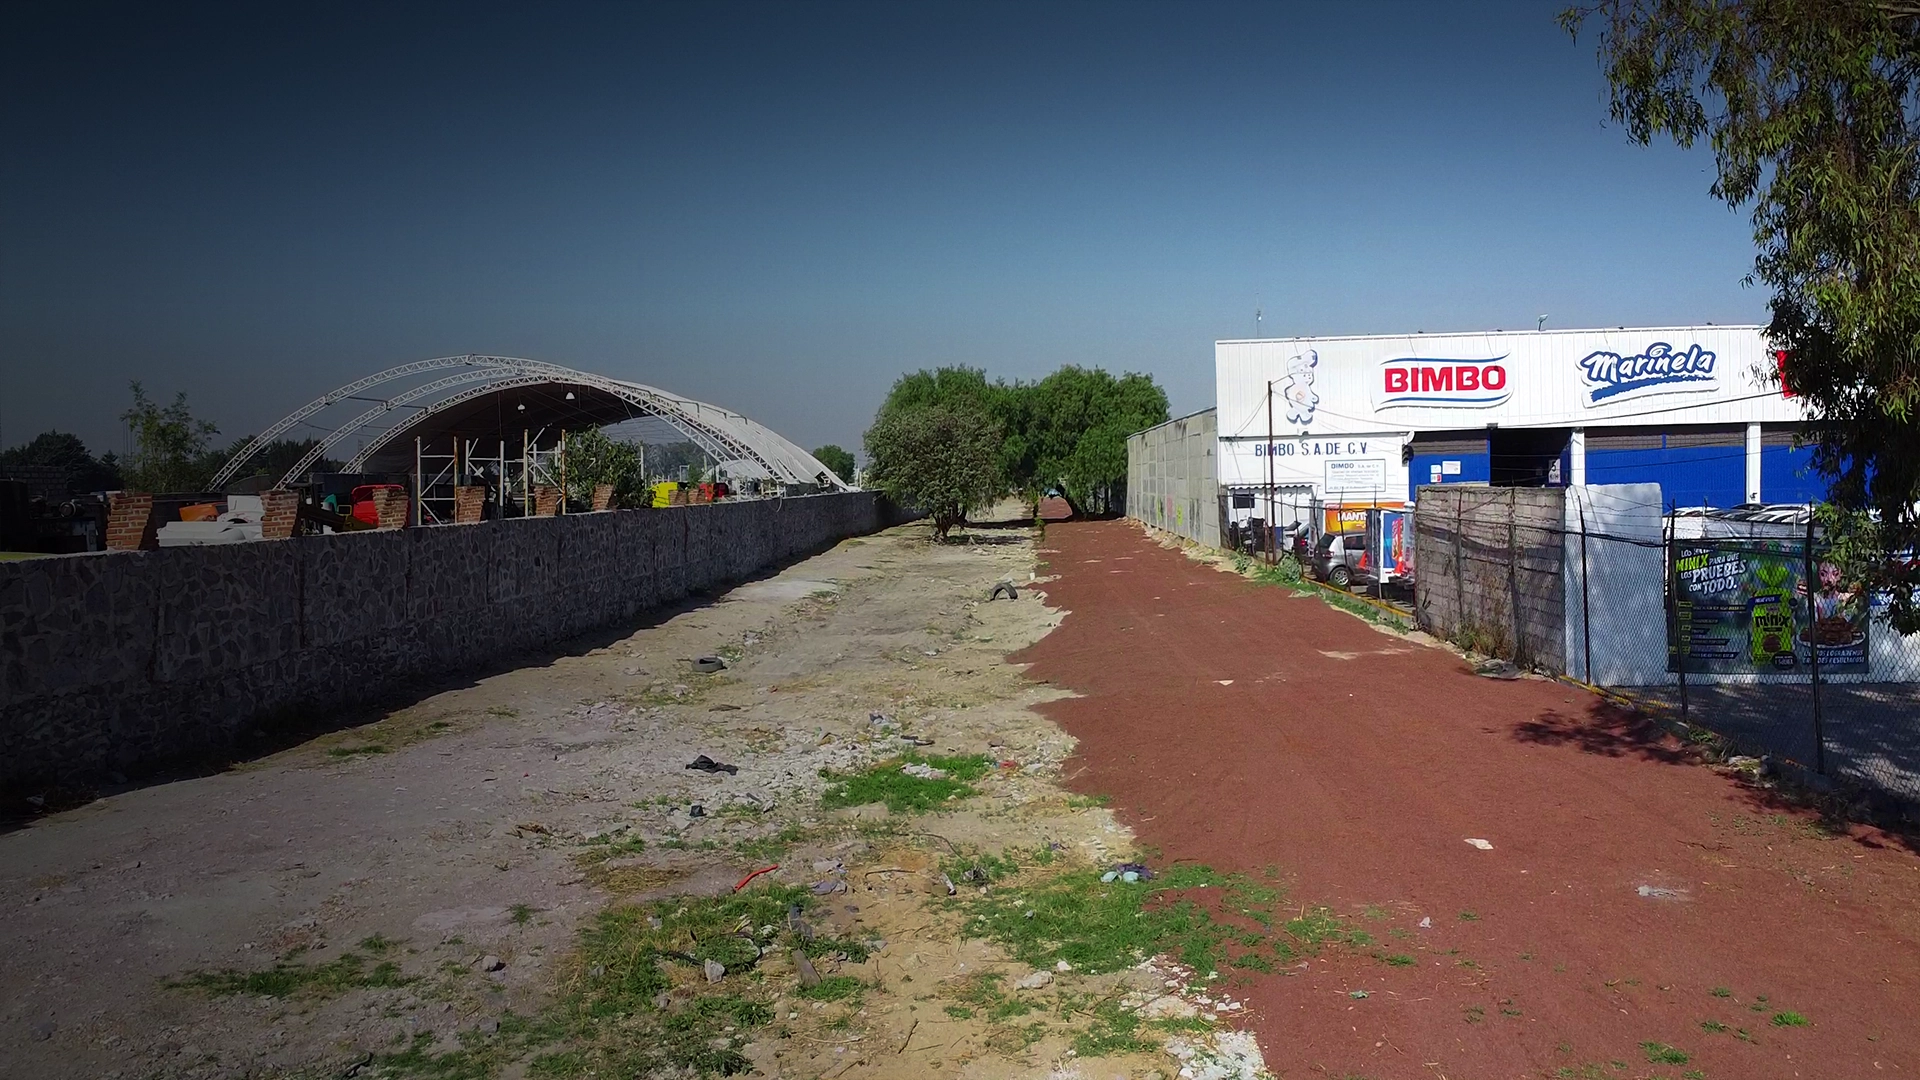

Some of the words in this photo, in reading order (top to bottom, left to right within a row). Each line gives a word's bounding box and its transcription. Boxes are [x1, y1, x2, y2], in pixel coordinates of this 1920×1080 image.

[1580, 342, 1717, 384] Marinela
[1384, 365, 1507, 393] BIMBO
[1255, 443, 1295, 457] BIMBO
[1675, 553, 1709, 573] MINIX
[1680, 571, 1693, 580] LOS
[1692, 559, 1747, 583] PRUEBES
[1689, 583, 1702, 592] CON
